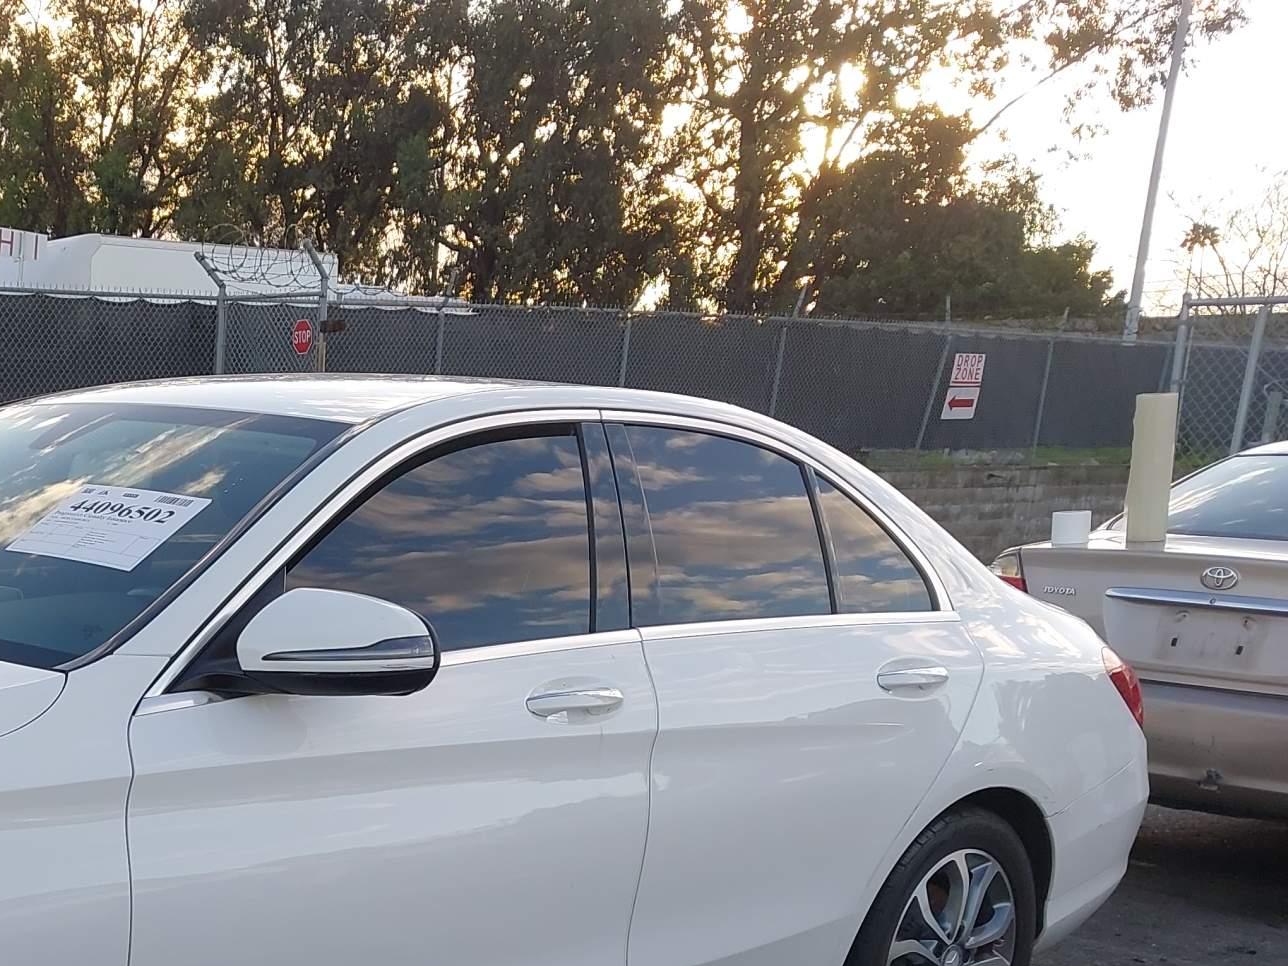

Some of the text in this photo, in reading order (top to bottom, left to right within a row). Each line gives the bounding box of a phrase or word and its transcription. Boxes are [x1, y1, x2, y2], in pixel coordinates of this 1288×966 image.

[294, 329, 311, 344] STOP
[957, 355, 983, 367] DROP
[955, 368, 981, 380] ZONE
[70, 500, 175, 524] 44096502
[1043, 585, 1076, 596] TOYOTA
